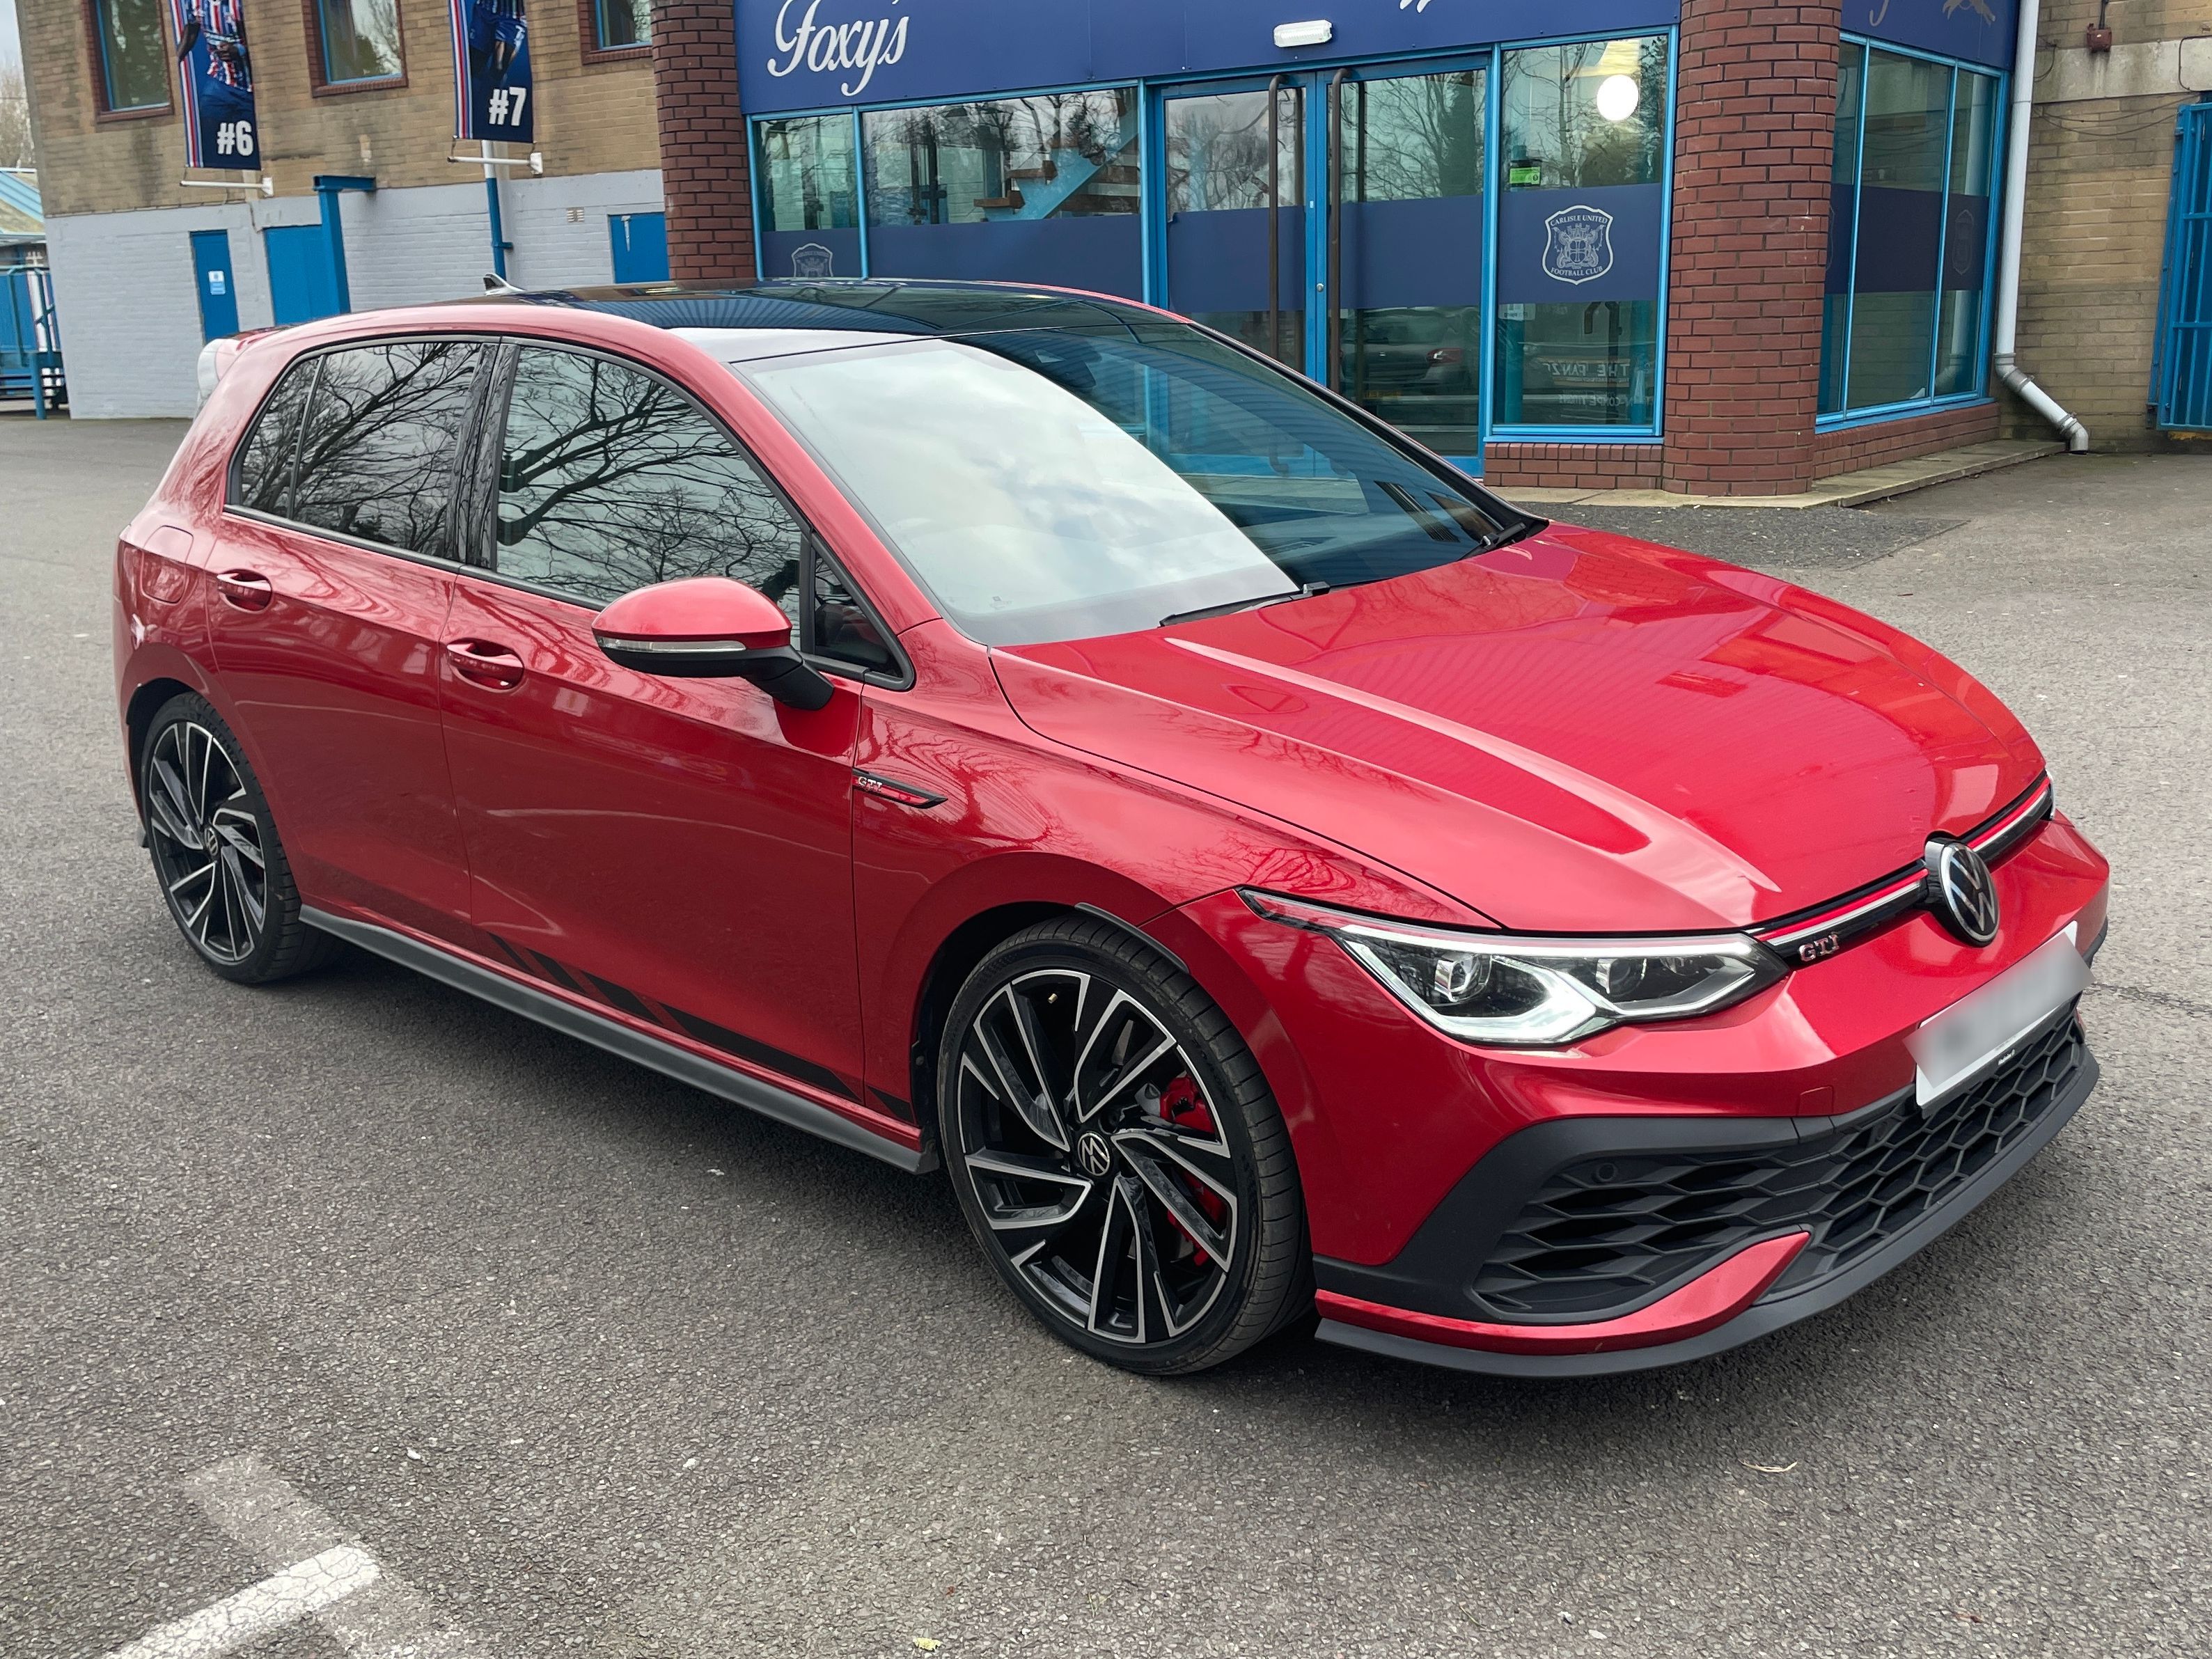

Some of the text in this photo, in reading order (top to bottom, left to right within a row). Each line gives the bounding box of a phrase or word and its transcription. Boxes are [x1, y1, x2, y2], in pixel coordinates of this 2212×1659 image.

[767, 0, 909, 96] Foxys
[489, 86, 526, 126] #7
[217, 120, 253, 156] #6
[1550, 214, 1608, 226] CARLISLE UNITED
[1550, 265, 1603, 276] FOOTBALL CLUB
[858, 776, 882, 788] GTI
[1798, 934, 1839, 961] GTI
